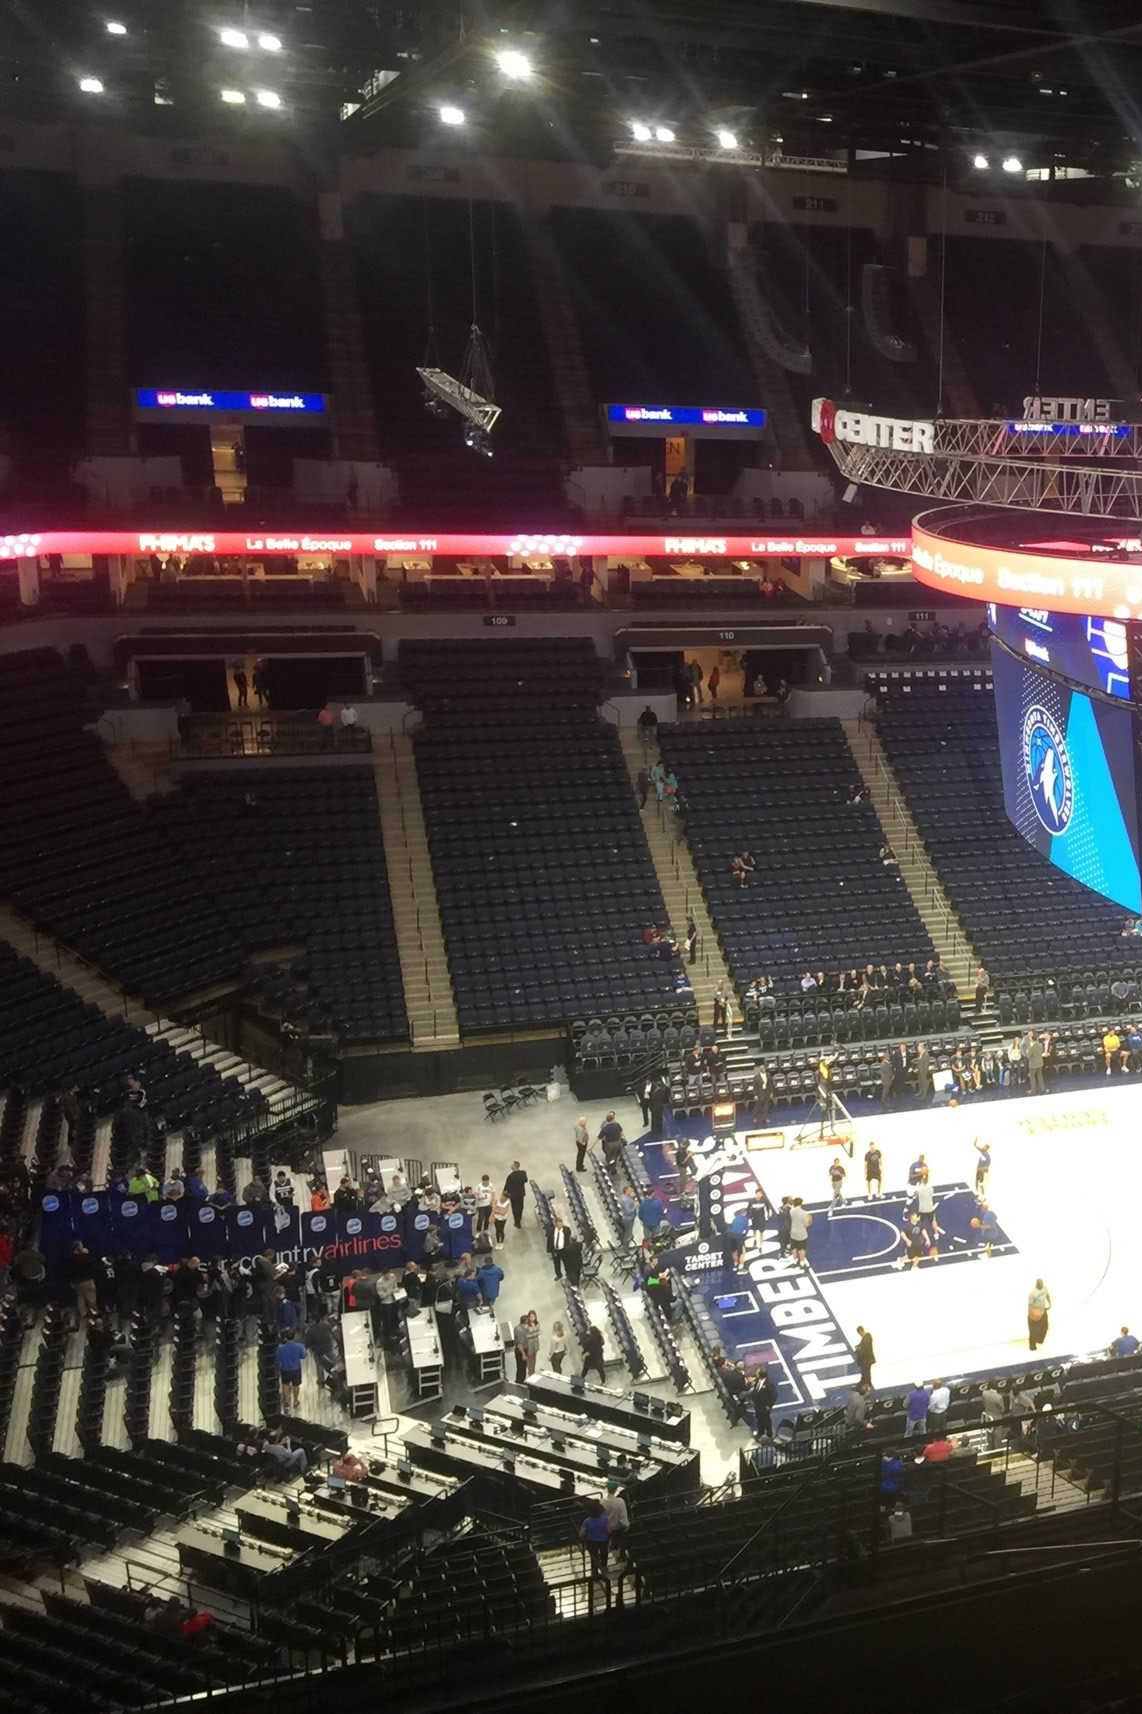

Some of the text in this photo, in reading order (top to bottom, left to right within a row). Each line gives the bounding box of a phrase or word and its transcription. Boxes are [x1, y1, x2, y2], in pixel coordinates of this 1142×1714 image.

[615, 182, 637, 194] 210
[805, 198, 825, 209] 211
[976, 212, 995, 223] 212
[834, 409, 935, 454] CENTER
[719, 631, 735, 640] 110
[684, 1251, 724, 1265] TARGET
[684, 1259, 724, 1272] CENTER
